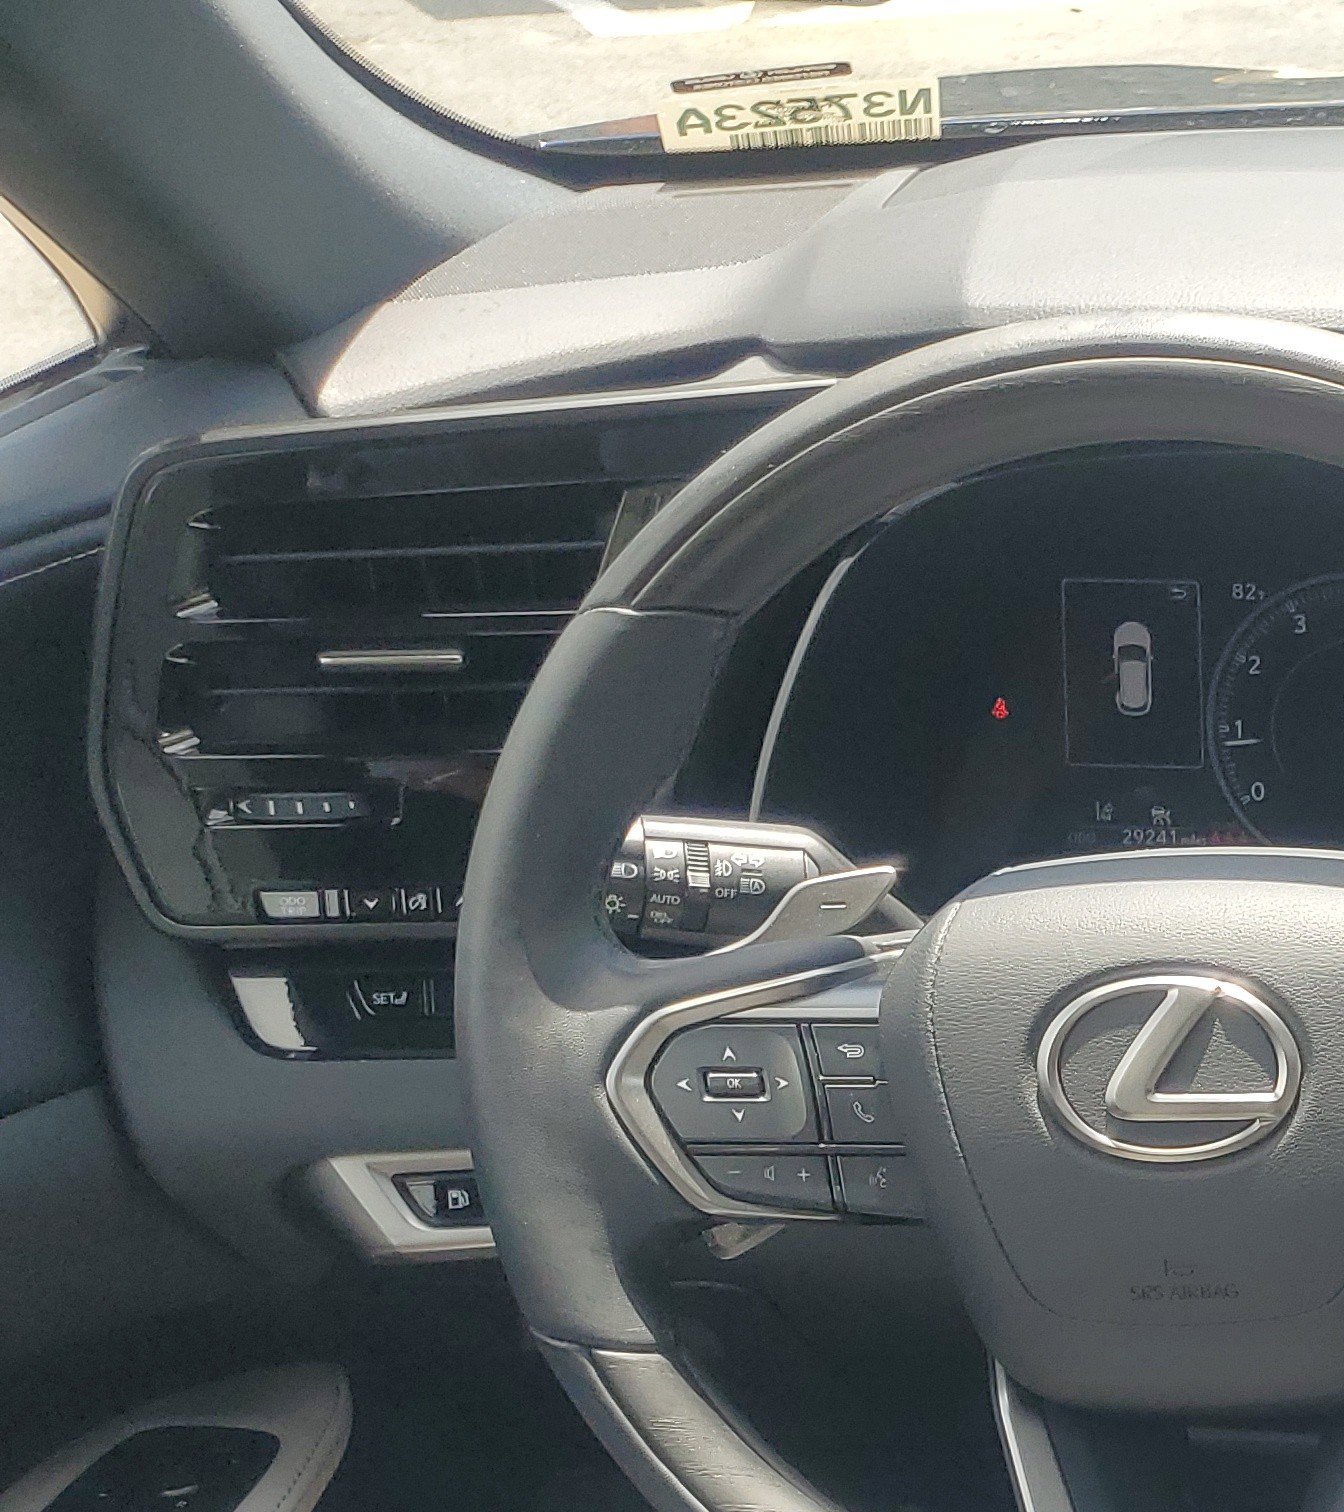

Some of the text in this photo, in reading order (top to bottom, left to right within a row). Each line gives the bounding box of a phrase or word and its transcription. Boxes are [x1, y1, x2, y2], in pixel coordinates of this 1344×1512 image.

[1294, 615, 1307, 634] 3
[1249, 655, 1261, 675] 2
[1235, 719, 1243, 739] 1
[1251, 782, 1265, 801] 0
[1122, 829, 1177, 845] 29241
[650, 894, 680, 905] AUTO
[715, 888, 737, 899] OFF
[372, 992, 395, 1005] SET
[726, 1079, 742, 1090] OK
